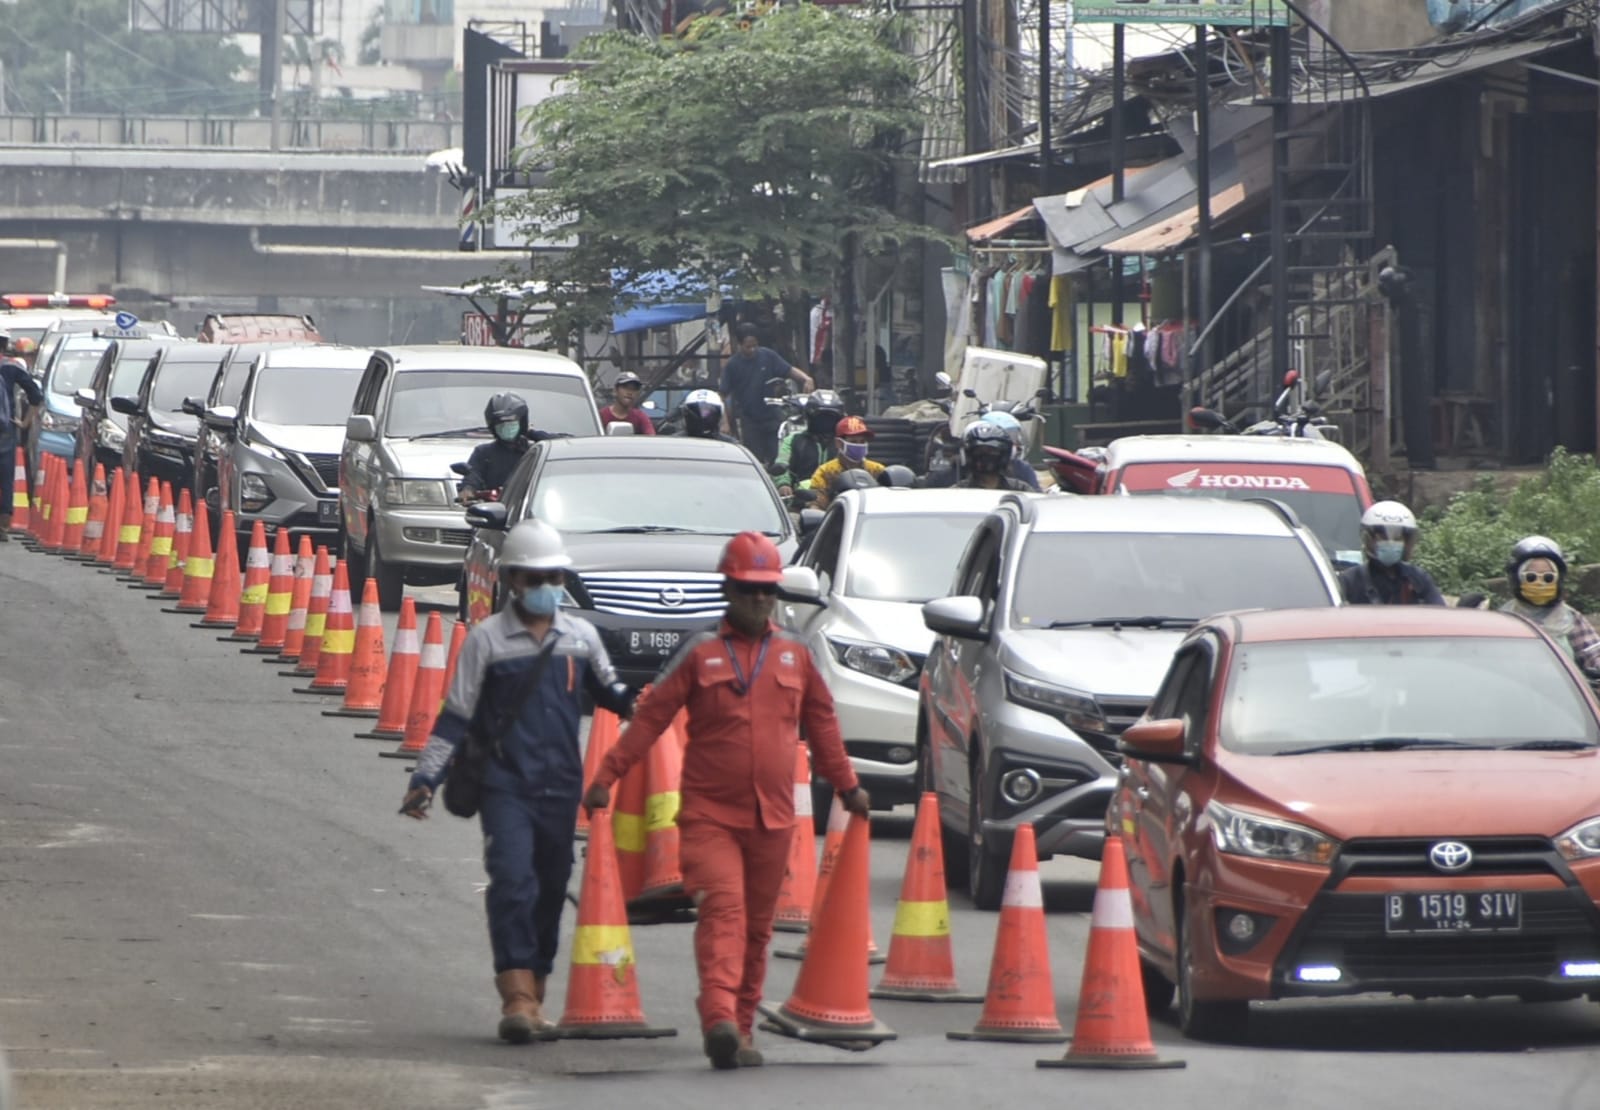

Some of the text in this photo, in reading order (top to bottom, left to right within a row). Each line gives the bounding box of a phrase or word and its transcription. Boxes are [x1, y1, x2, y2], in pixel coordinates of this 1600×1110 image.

[111, 329, 142, 337] TAKSI
[1199, 474, 1310, 491] HONDA
[630, 631, 640, 648] B
[1390, 892, 1517, 918] B 1519 SIV
